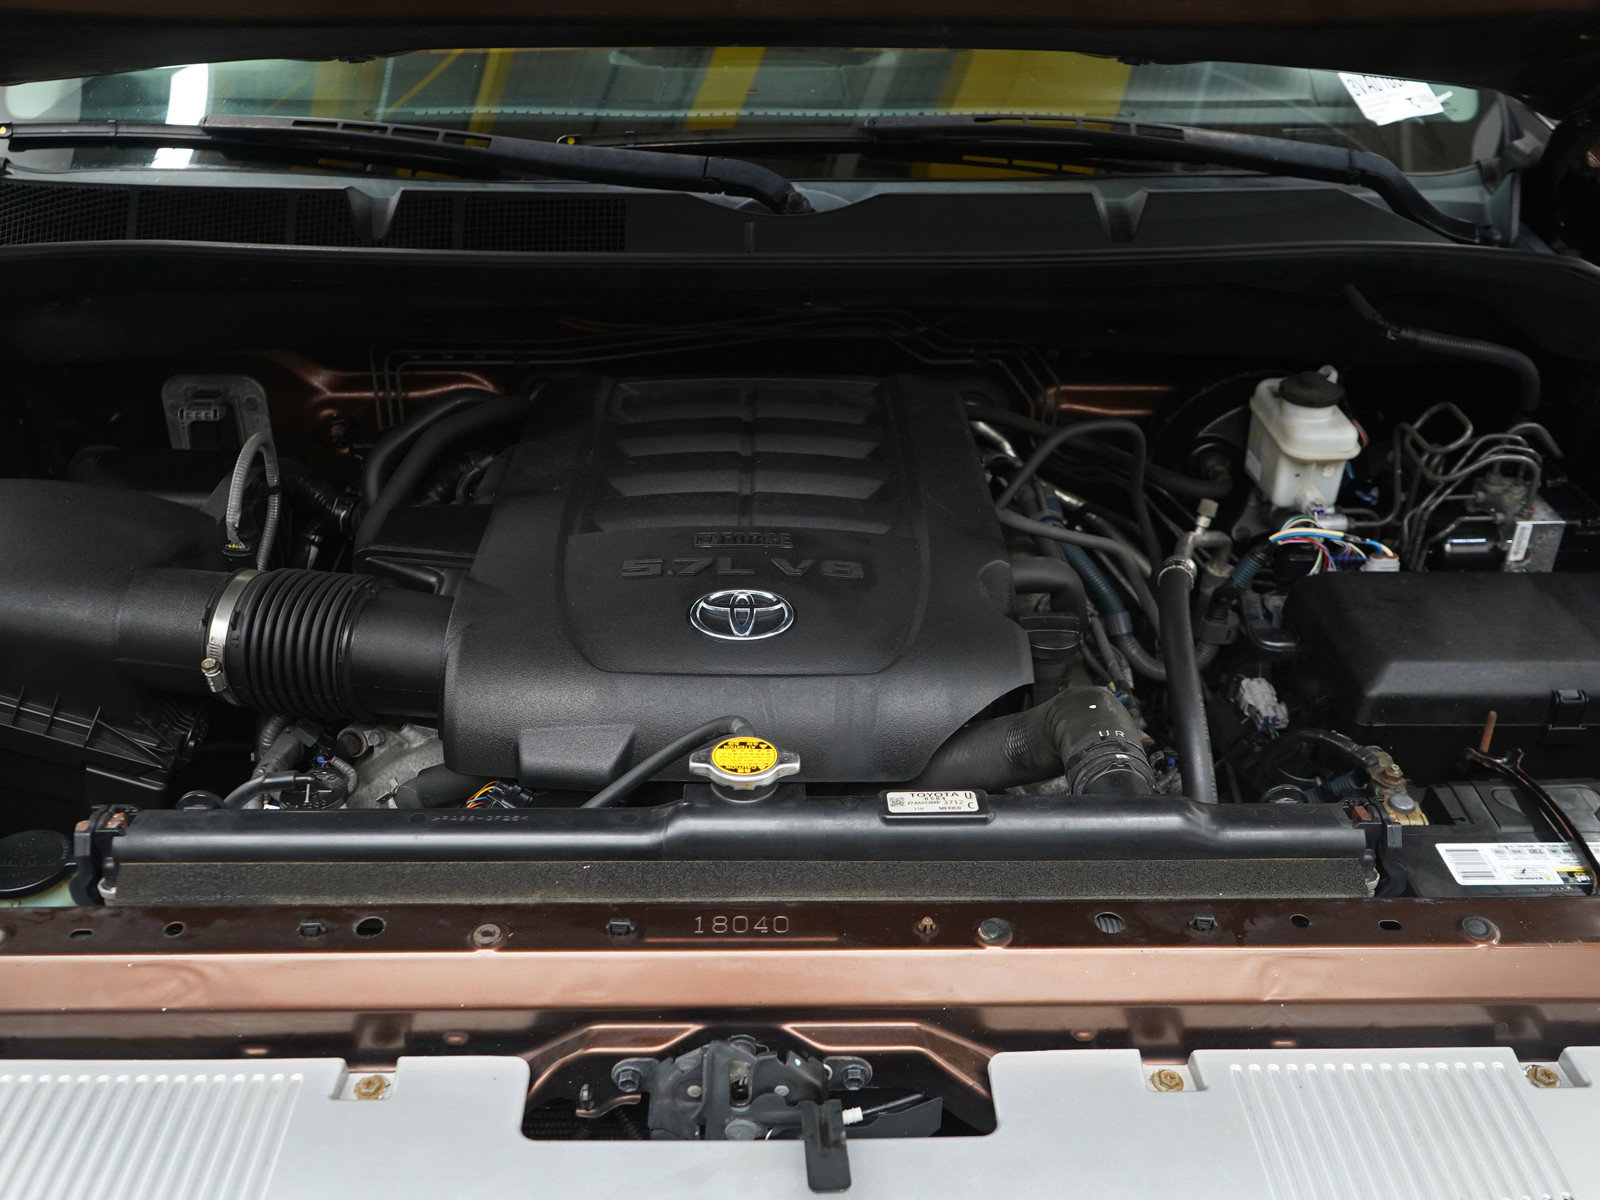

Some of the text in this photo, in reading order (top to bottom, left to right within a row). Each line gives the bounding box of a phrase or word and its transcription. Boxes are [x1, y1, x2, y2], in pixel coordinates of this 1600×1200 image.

[621, 556, 865, 580] 5.7L V8
[964, 792, 973, 800] U
[967, 801, 975, 810] C
[693, 915, 790, 934] 18040
